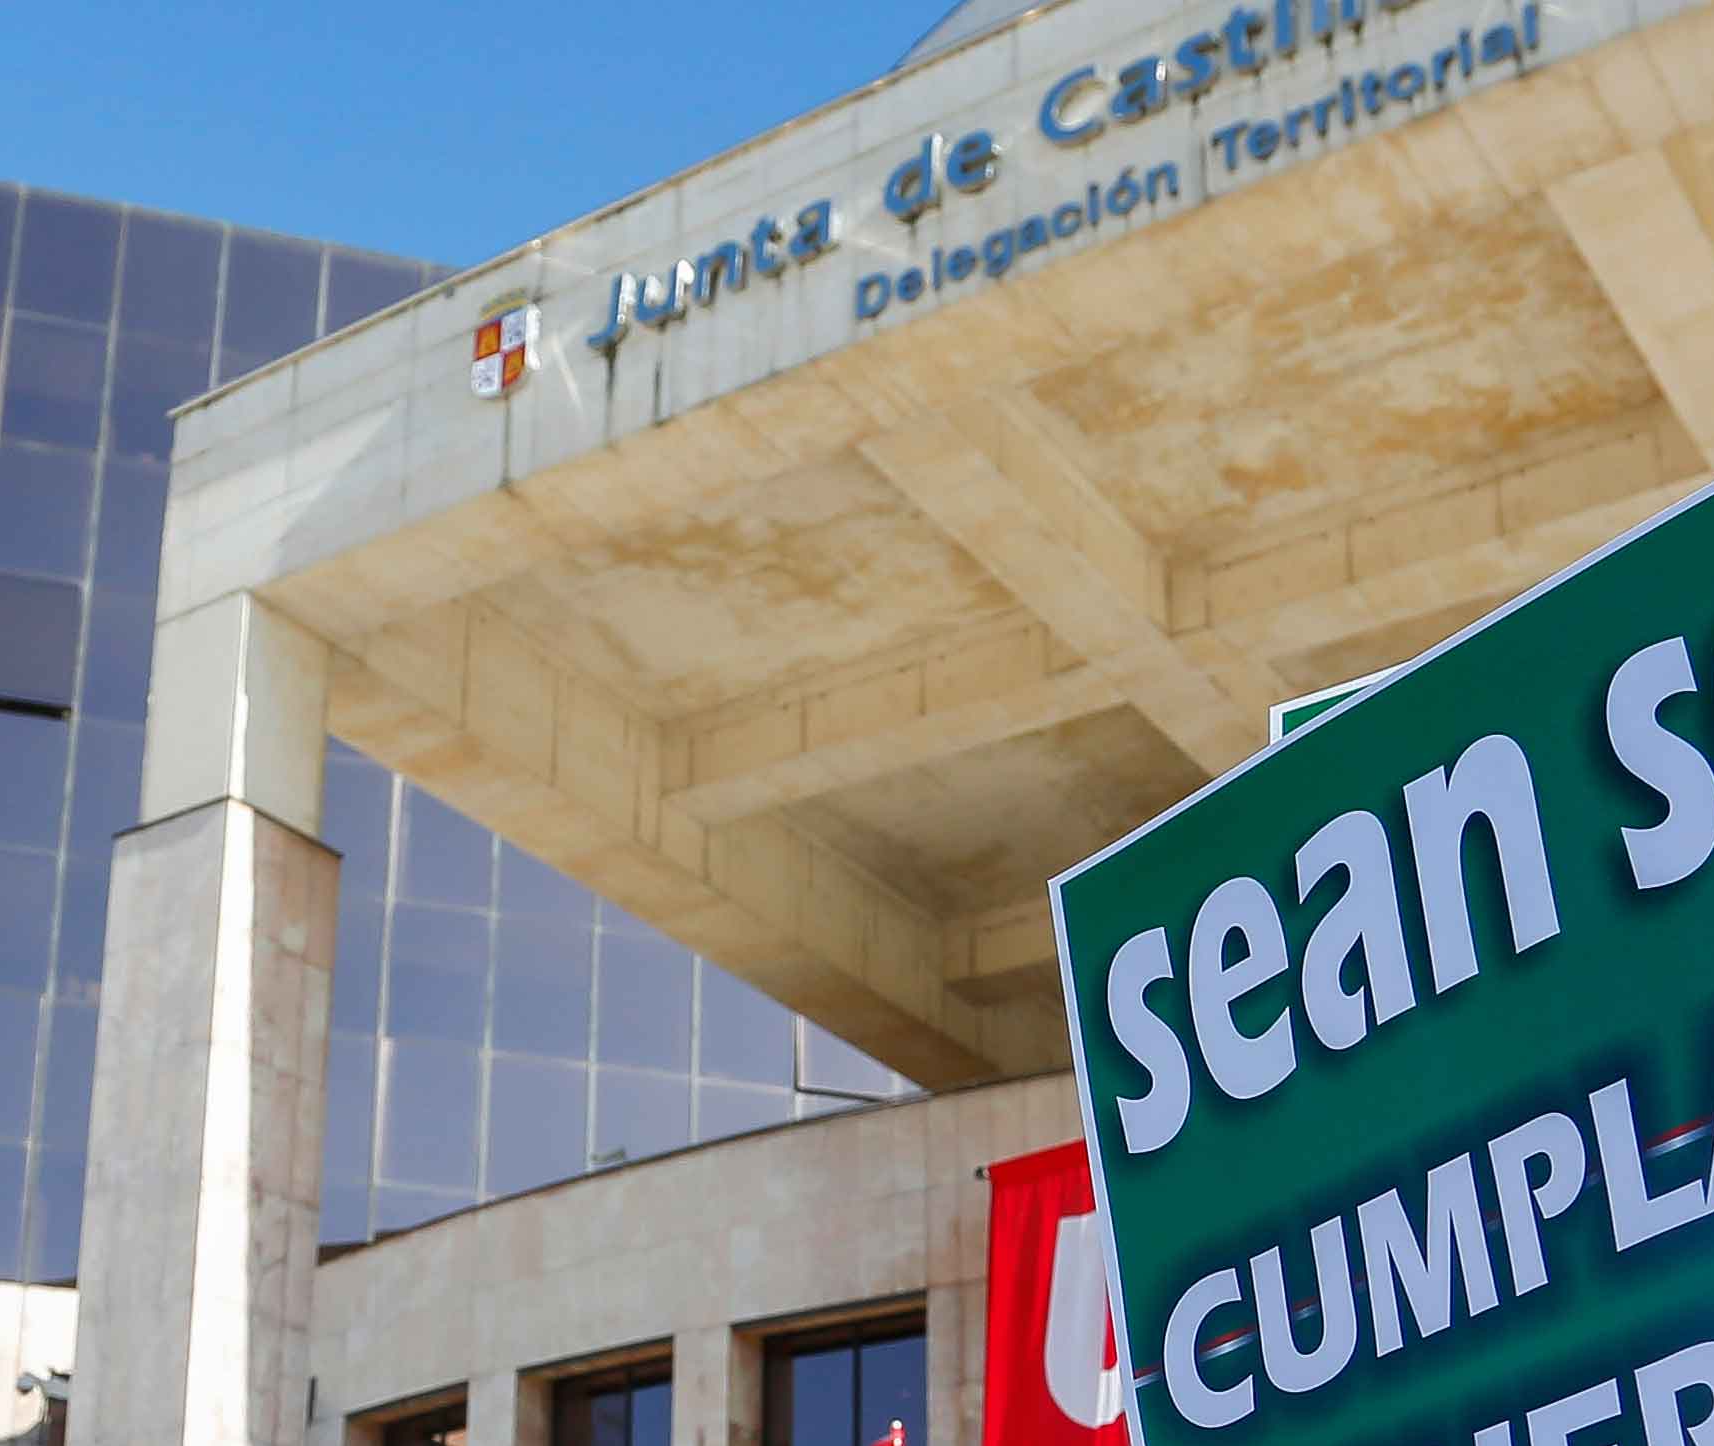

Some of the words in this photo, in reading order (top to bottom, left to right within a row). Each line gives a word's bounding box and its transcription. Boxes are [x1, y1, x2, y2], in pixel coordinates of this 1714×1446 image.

[587, 198, 843, 358] Junta
[884, 128, 999, 218] de
[854, 160, 1180, 322] Delegación
[1210, 2, 1541, 172] Territorial
[1105, 733, 1560, 1155] sean
